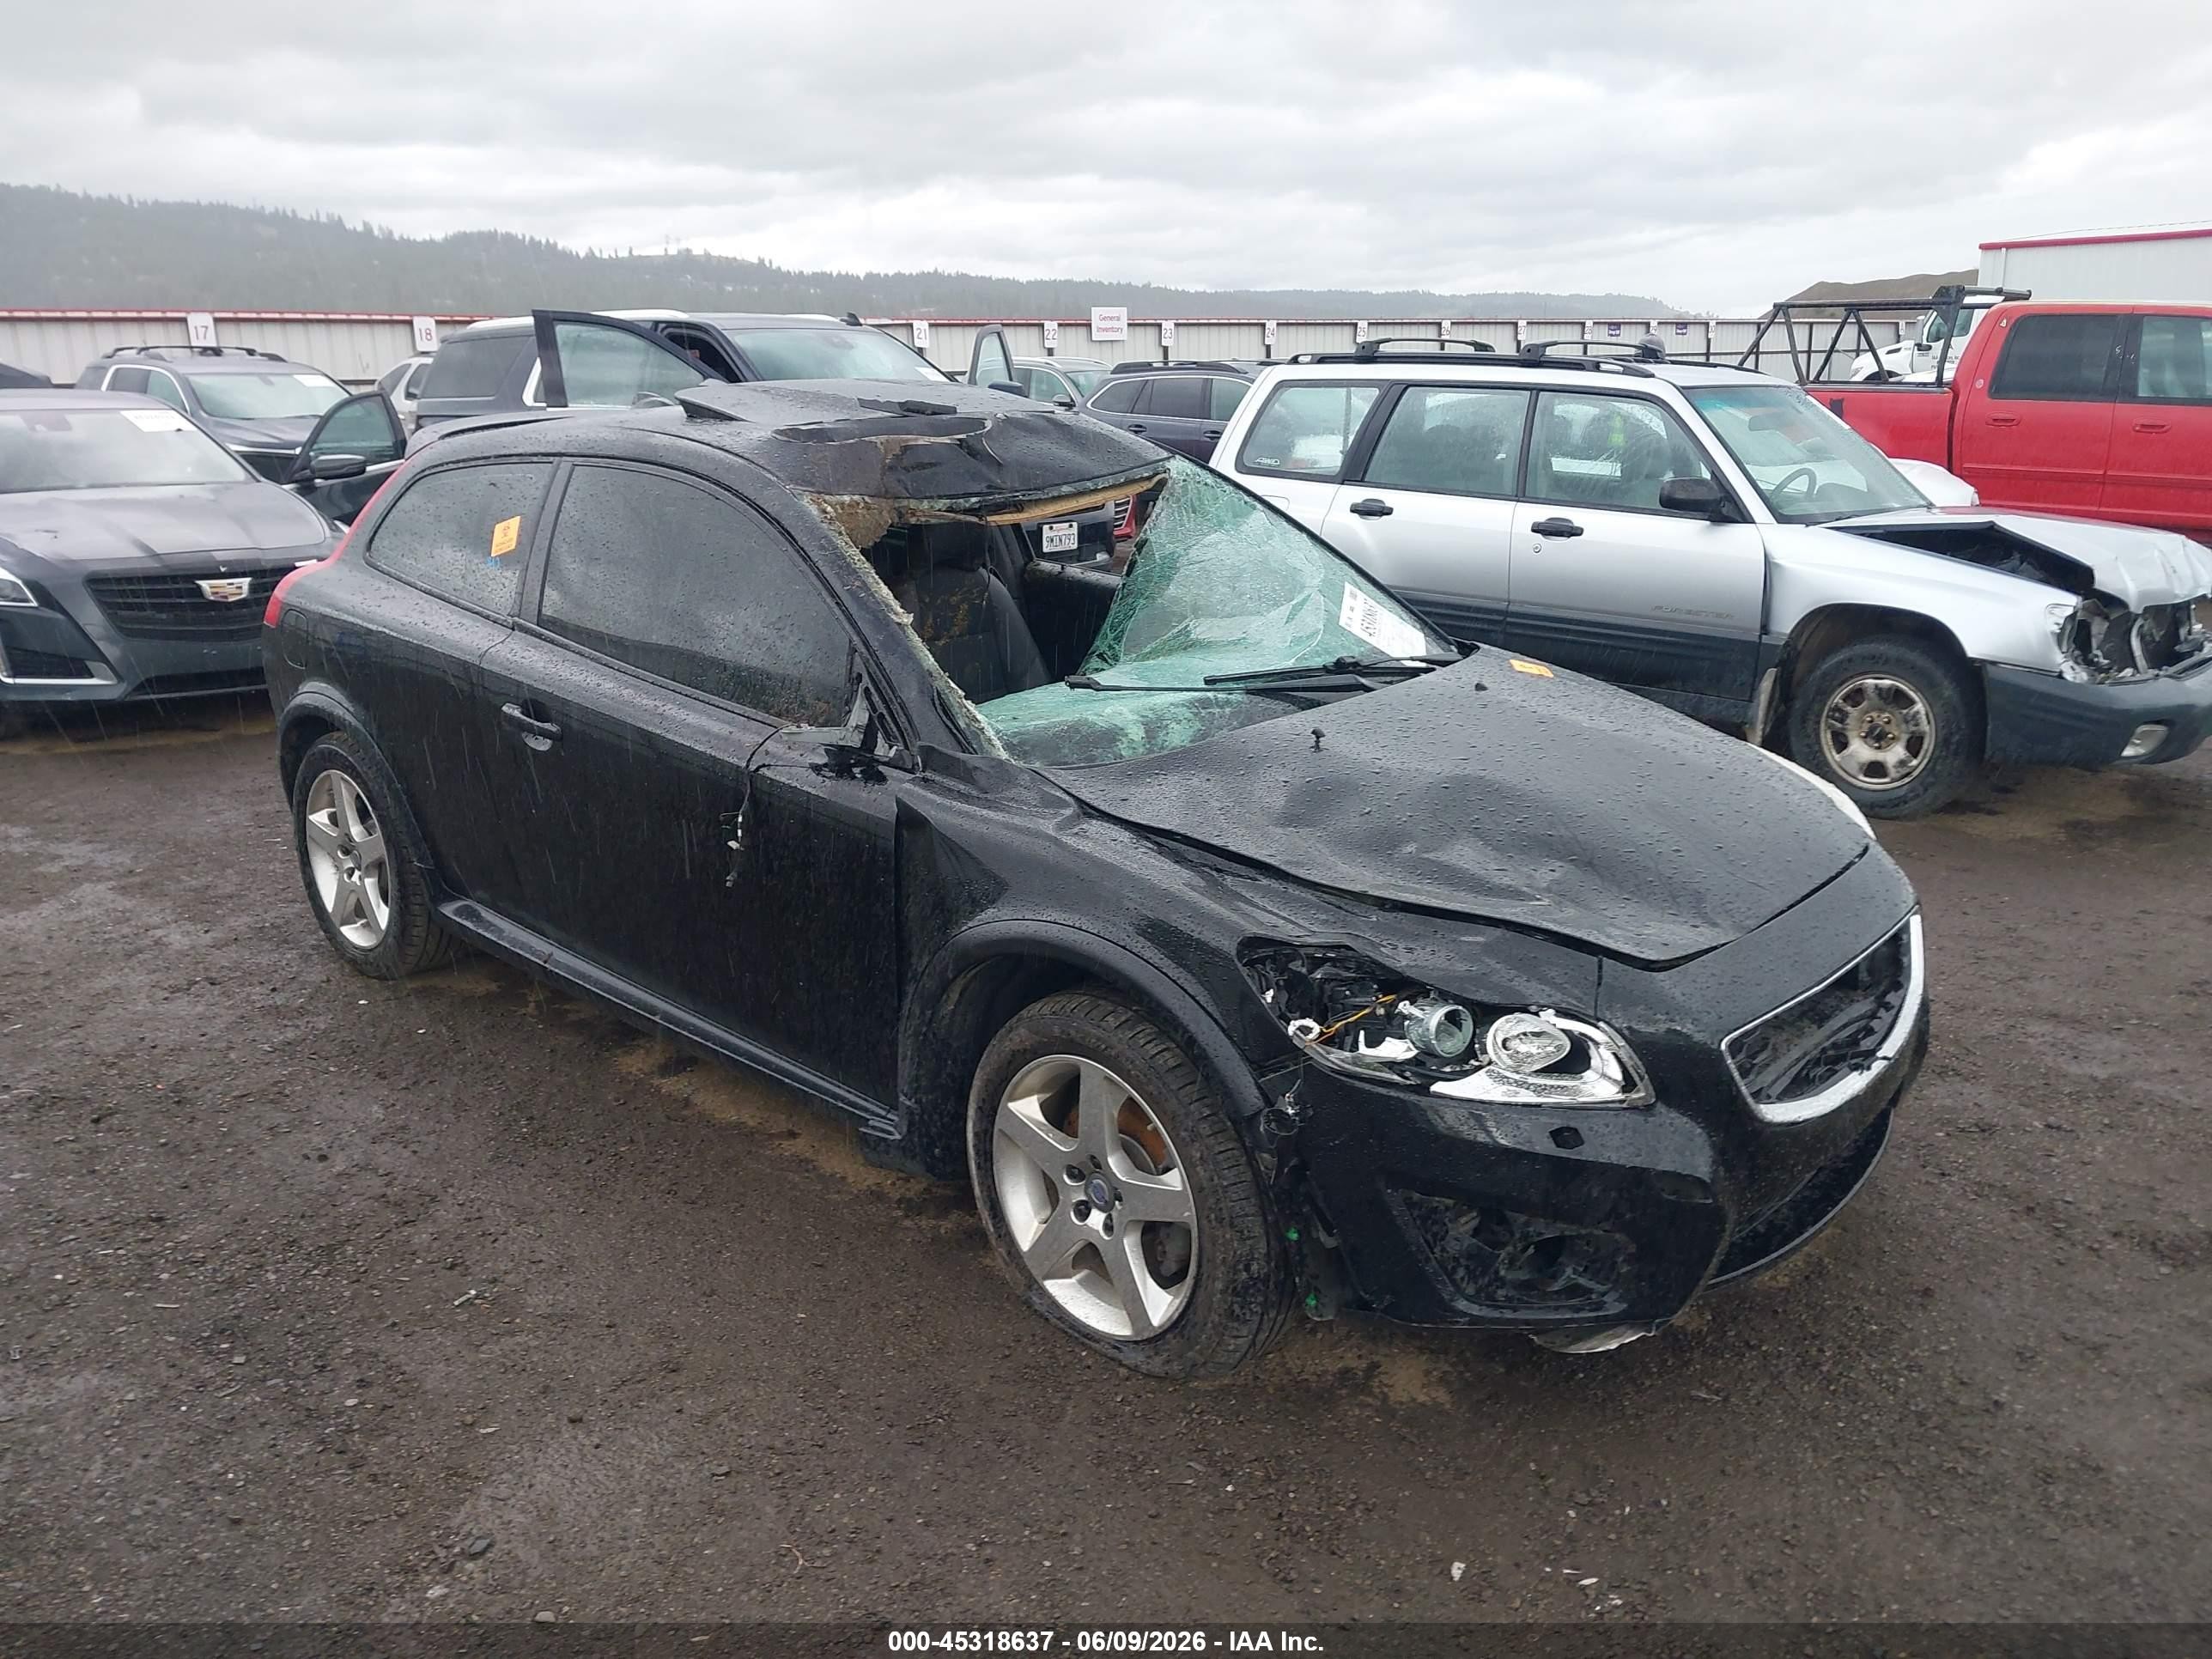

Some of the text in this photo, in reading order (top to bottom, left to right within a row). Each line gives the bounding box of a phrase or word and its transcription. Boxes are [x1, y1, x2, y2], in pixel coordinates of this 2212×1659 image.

[1098, 313, 1121, 322] General
[193, 325, 209, 341] 17
[418, 327, 433, 342] 18
[915, 327, 927, 340] 21
[1044, 328, 1057, 340] 22
[1096, 325, 1123, 334] Inventory
[1163, 327, 1173, 339] 23
[1266, 327, 1275, 338] 24
[1358, 326, 1366, 337] 25
[1442, 325, 1450, 336] 26
[1518, 325, 1526, 335] 27
[1255, 457, 1280, 465] AWD
[1045, 532, 1076, 549] 9MIN793
